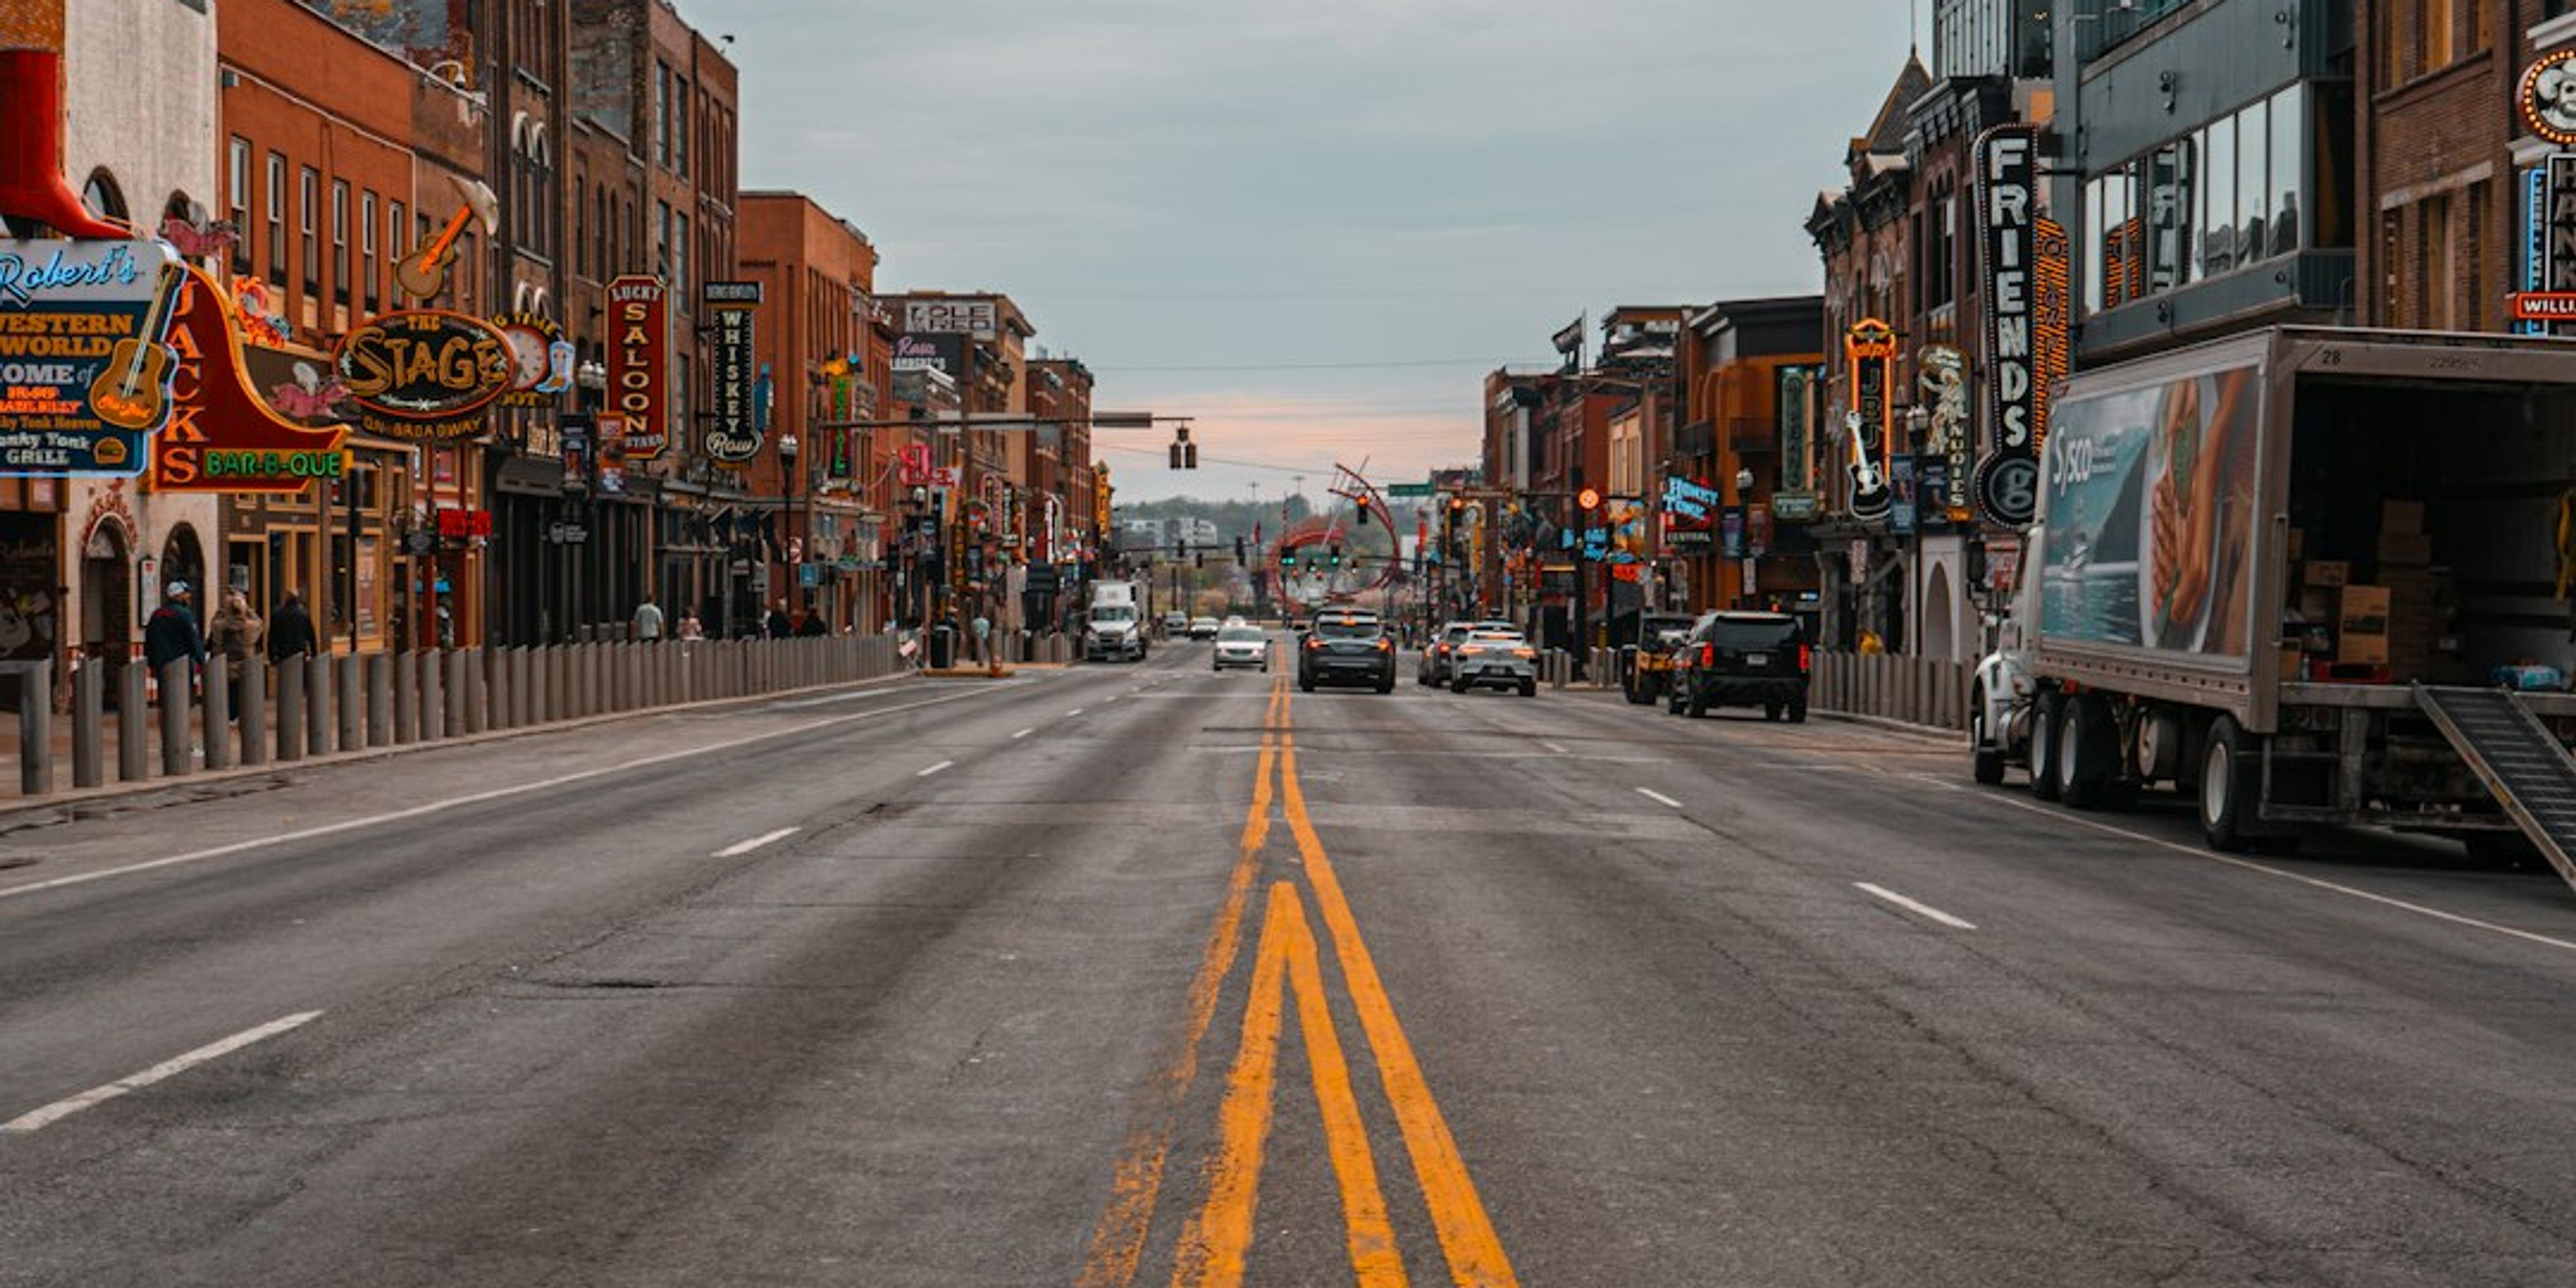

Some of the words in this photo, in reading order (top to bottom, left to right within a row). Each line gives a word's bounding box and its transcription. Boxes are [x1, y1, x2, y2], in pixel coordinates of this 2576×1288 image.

[0, 246, 136, 302] Robert's
[611, 286, 661, 302] LUCKY
[1990, 138, 2028, 447] FRIENDS
[2523, 299, 2576, 313] WILLI
[408, 315, 441, 331] THE
[0, 336, 112, 357] WORLD
[2322, 350, 2341, 366] 28
[0, 363, 74, 385] OME
[346, 327, 508, 397] STAGE
[621, 303, 649, 433] SALOON
[722, 311, 743, 433] WHISKEY
[362, 415, 385, 433] ON
[393, 417, 483, 437] BROADWAY
[5, 445, 70, 466] GRILL
[712, 431, 753, 458] Row
[206, 452, 341, 477] BAR-B-QUE
[2054, 426, 2092, 496] Sysco
[1668, 476, 1719, 506] HONKY
[1663, 494, 1706, 521] TONK
